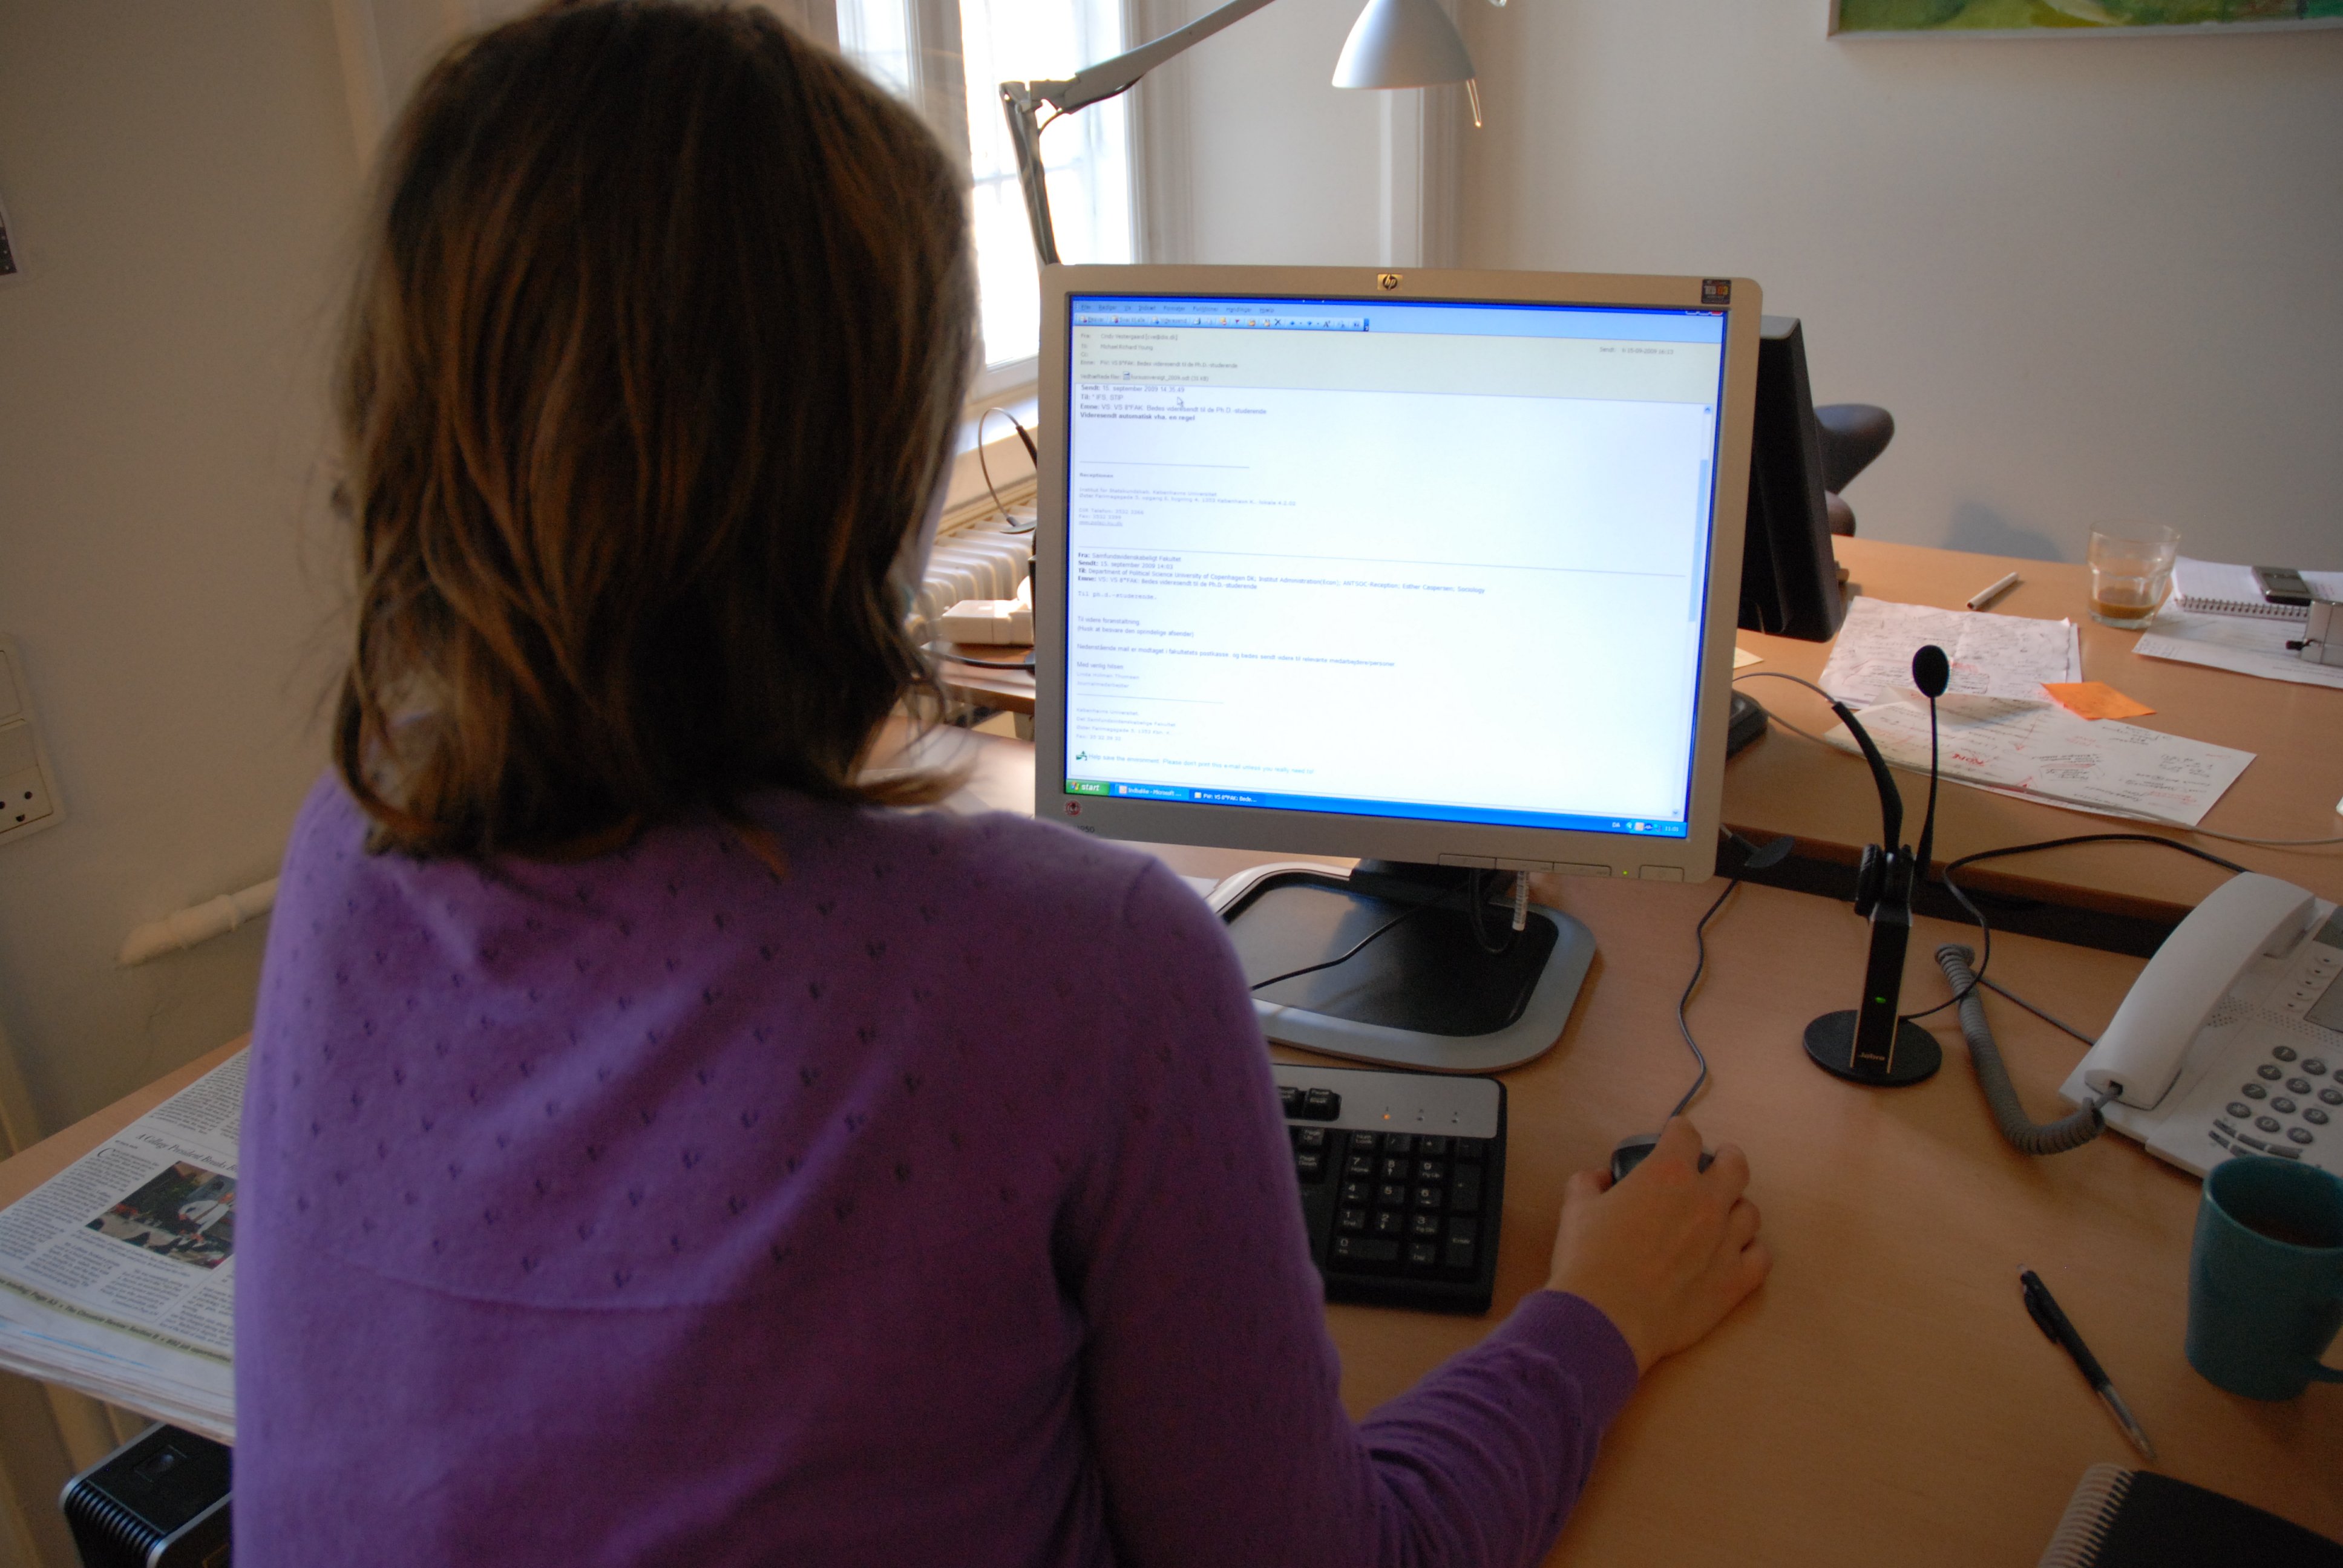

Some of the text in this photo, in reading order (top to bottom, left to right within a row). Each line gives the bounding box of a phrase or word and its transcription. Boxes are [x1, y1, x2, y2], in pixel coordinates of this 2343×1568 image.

[1152, 788, 1174, 797] Microsoft
[143, 1134, 169, 1149] College
[168, 1143, 204, 1160] President
[201, 1155, 227, 1168] Breaks
[76, 1310, 105, 1322] Chronicle
